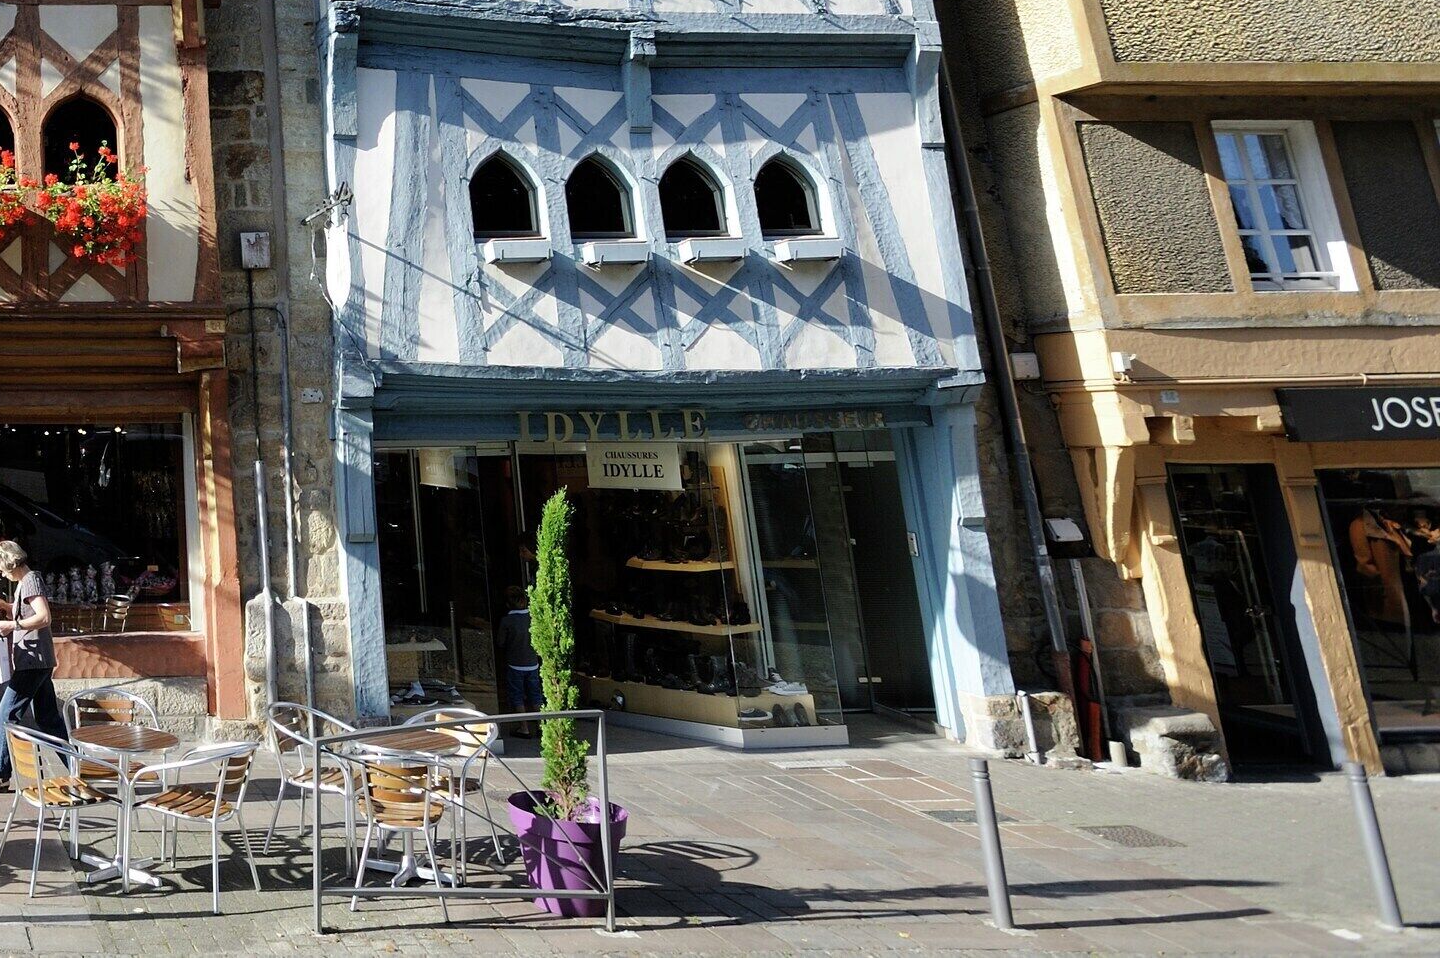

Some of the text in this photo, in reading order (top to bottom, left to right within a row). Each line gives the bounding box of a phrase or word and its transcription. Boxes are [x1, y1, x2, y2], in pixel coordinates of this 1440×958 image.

[515, 409, 709, 442] IDYLLE
[604, 451, 659, 460] CHAUSSURES
[602, 463, 665, 479] IDYLLE
